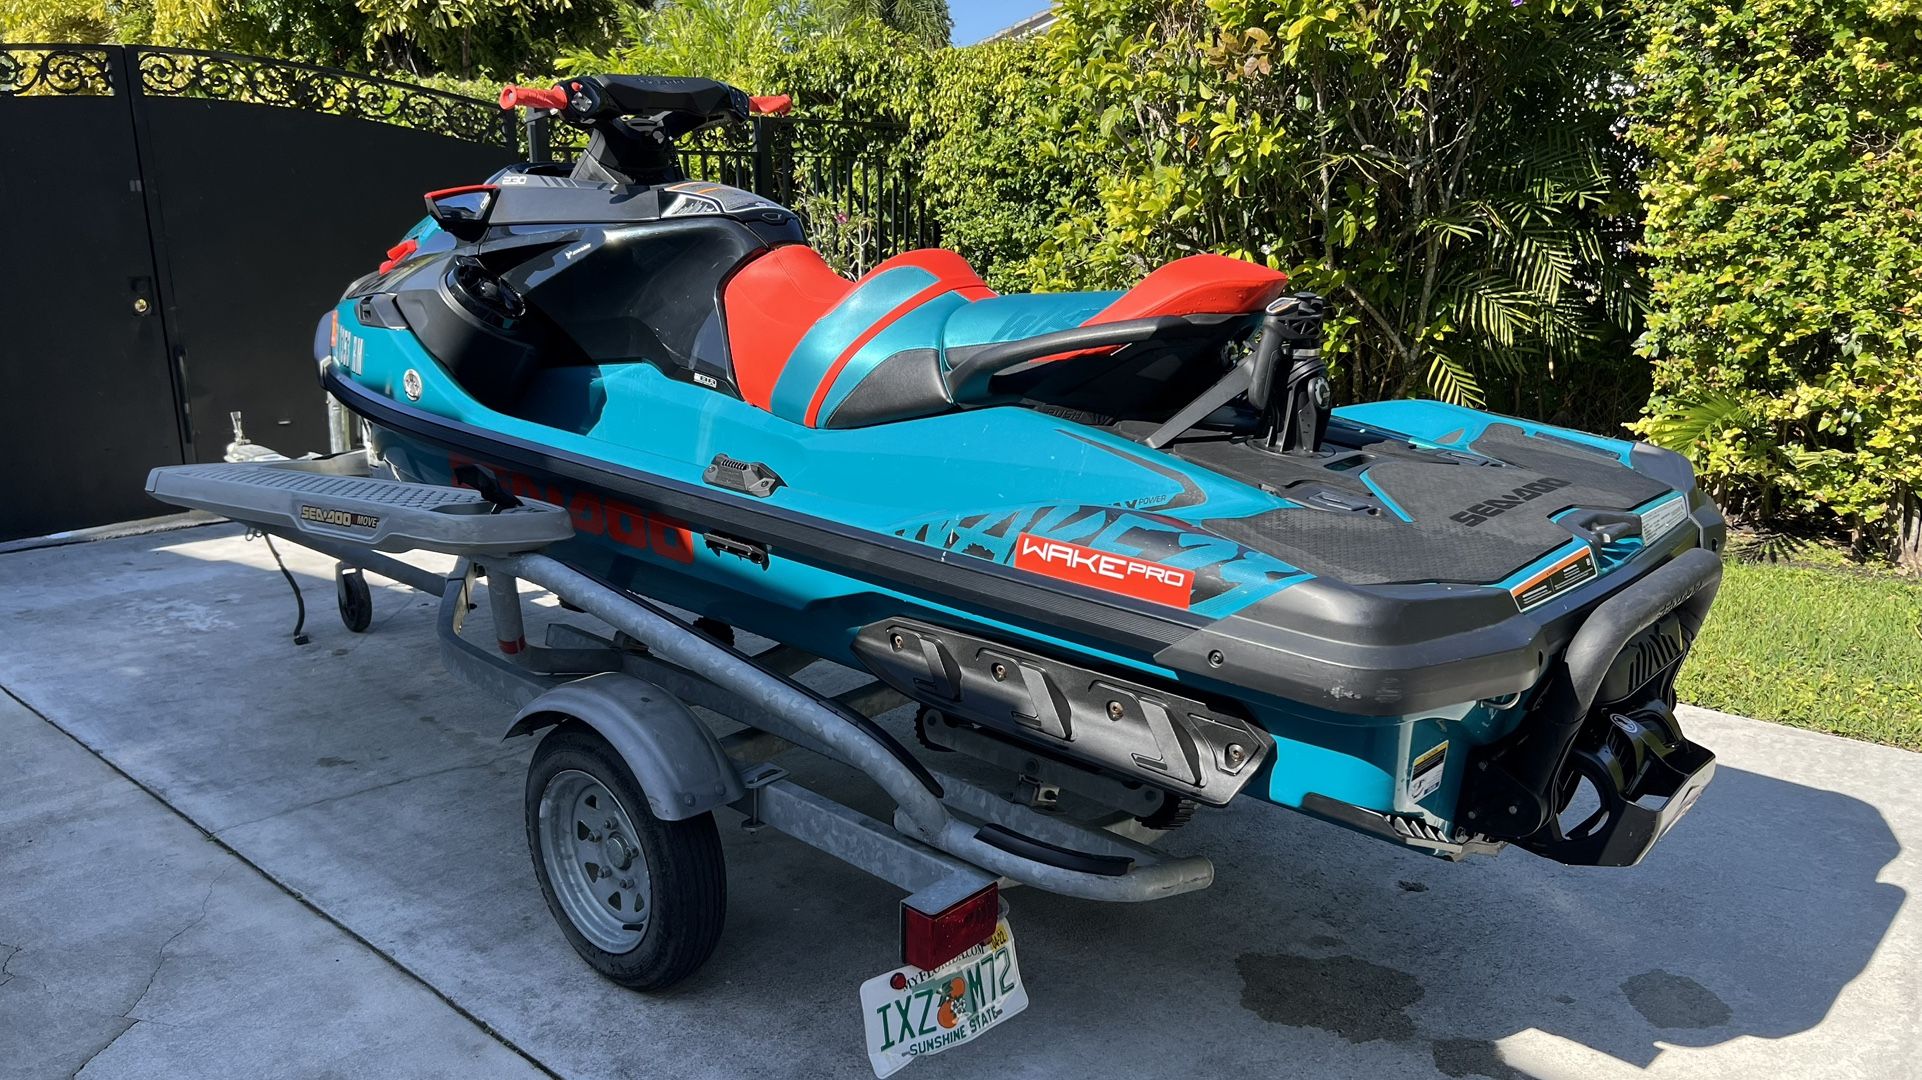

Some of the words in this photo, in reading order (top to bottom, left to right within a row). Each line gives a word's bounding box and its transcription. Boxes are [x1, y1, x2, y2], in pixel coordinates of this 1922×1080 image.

[501, 175, 528, 185] 230
[1138, 494, 1167, 505] POWER
[356, 514, 378, 528] MOVE
[1021, 537, 1127, 580] WAKE
[1127, 562, 1185, 587] PRO
[966, 946, 1015, 1013] M72
[909, 1028, 967, 1056] SUNSHINE
[969, 1006, 999, 1034] STATE
